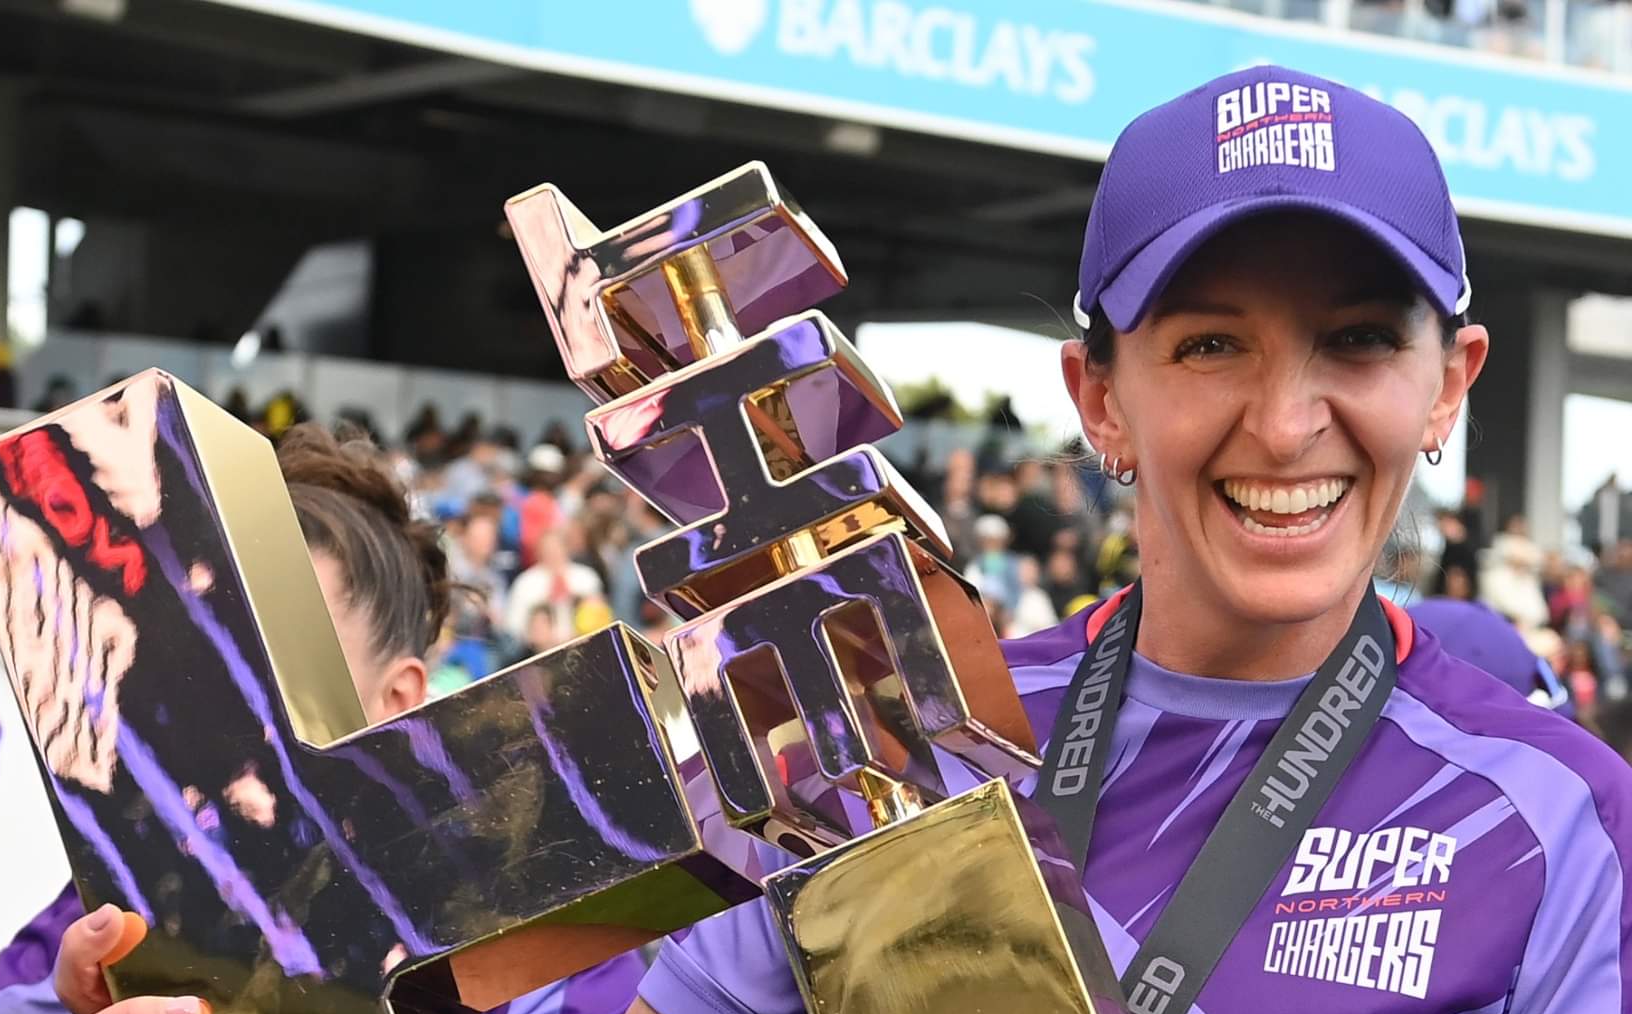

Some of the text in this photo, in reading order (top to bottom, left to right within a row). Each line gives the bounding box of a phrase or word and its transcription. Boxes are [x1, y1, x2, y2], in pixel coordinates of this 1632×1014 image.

[776, 0, 1099, 105] BARCLAYS
[1216, 82, 1331, 135] SUPER
[1218, 122, 1336, 174] CHARGERS
[1250, 634, 1386, 829] THE HUNDRED
[1280, 827, 1458, 897] SUPER
[1275, 890, 1447, 915] NORTHERN
[1263, 908, 1443, 1000] CHARGERS
